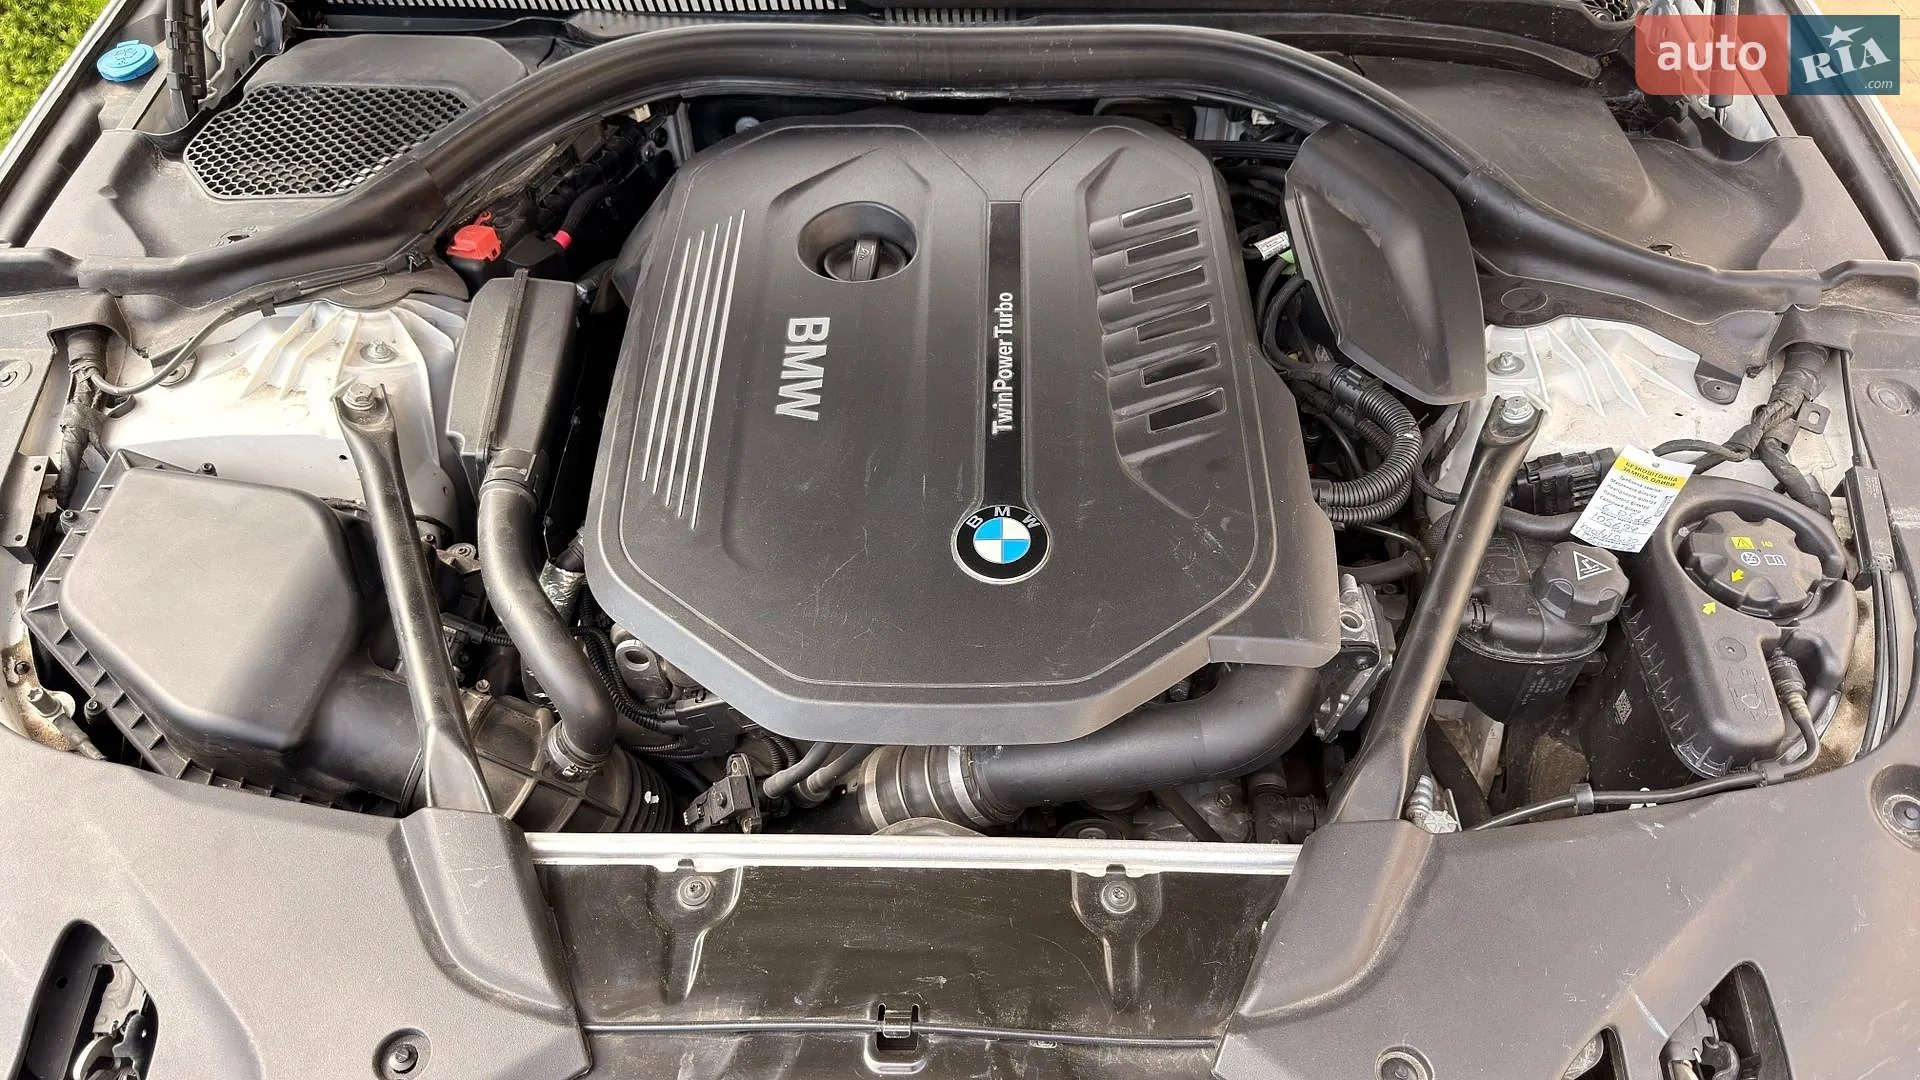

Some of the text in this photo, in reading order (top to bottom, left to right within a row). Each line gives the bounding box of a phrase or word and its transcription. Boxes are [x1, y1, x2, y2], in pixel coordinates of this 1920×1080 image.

[775, 317, 830, 421] BMW
[992, 292, 1013, 435] TwinPower Turbo
[1623, 467, 1676, 486] ЗАМІНА ОЛИВИ
[1626, 462, 1678, 482] БЕЗКОШТОВНА
[965, 506, 1041, 529] BMW
